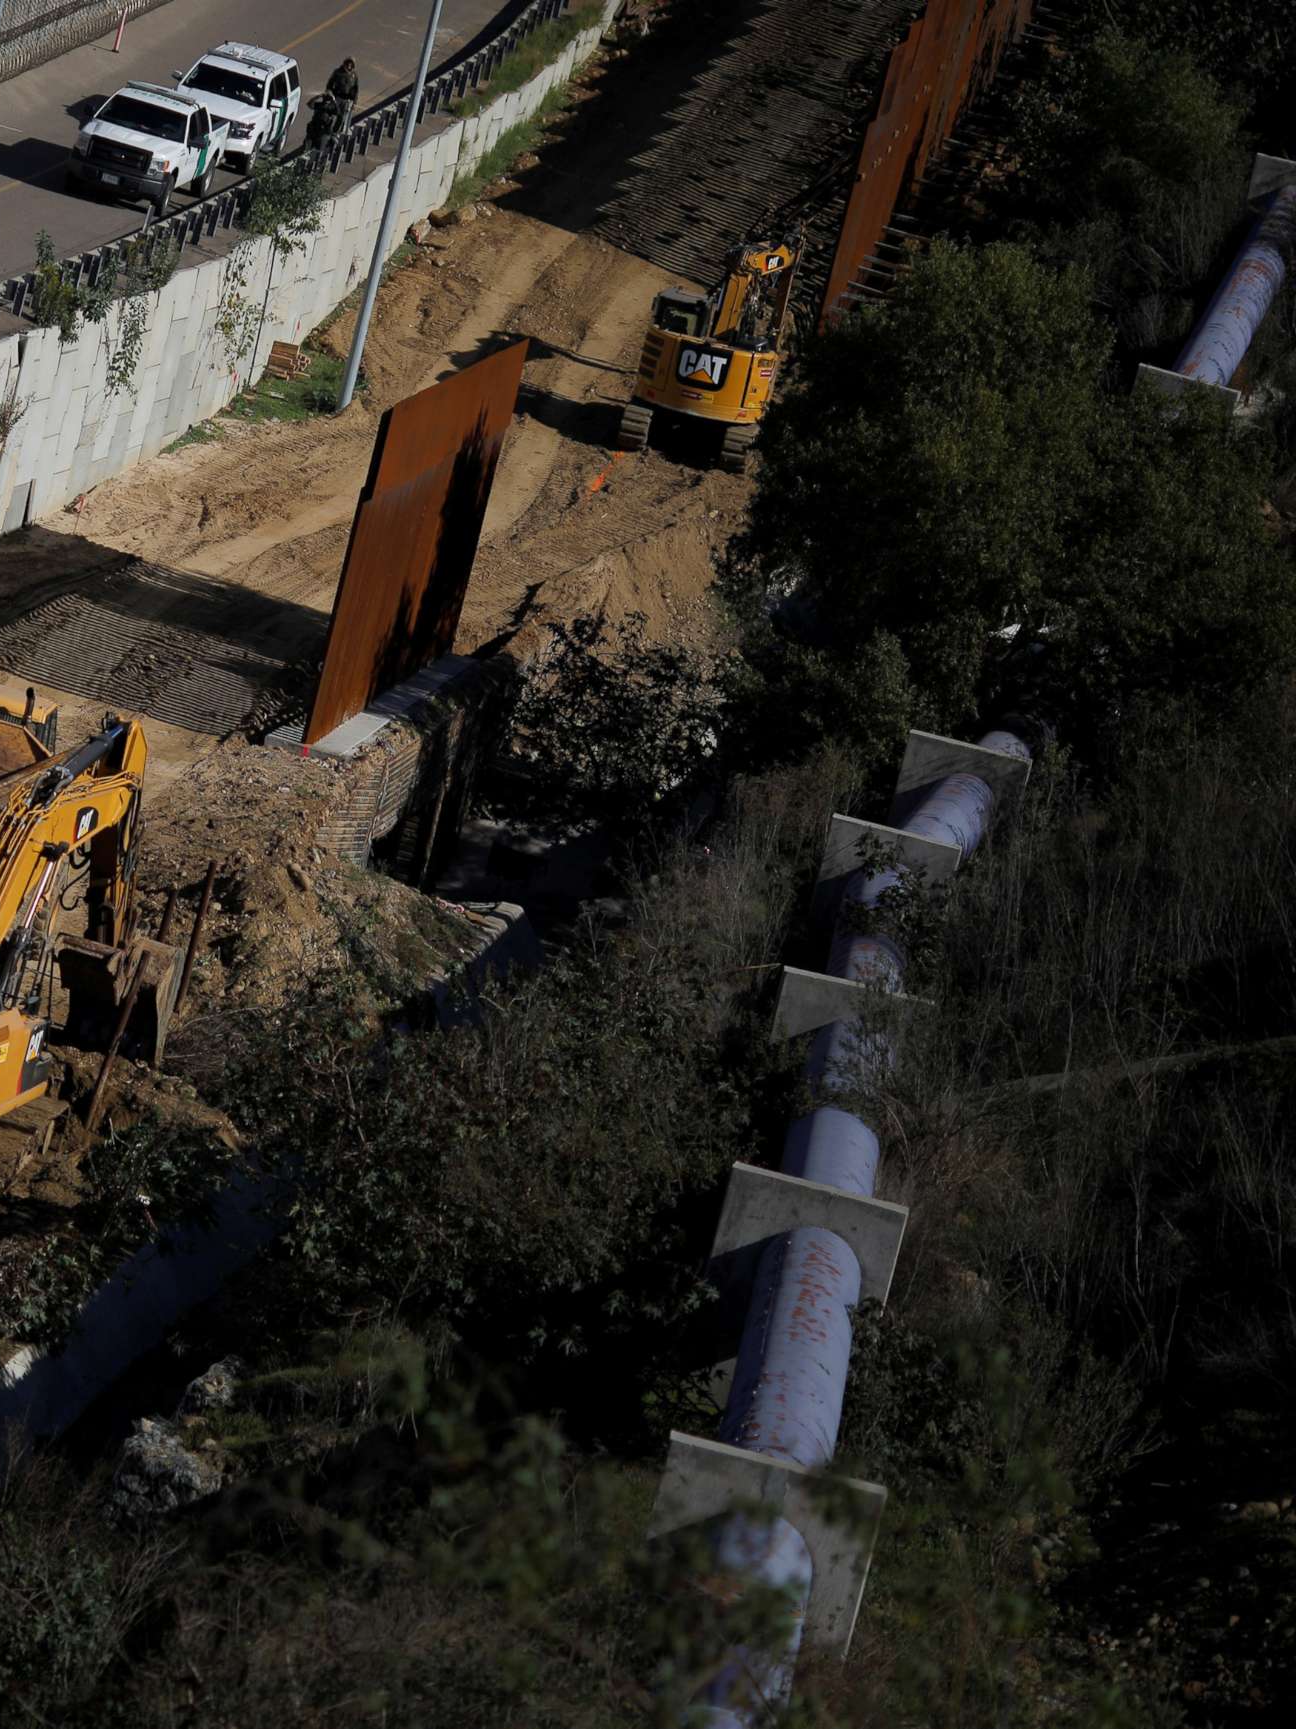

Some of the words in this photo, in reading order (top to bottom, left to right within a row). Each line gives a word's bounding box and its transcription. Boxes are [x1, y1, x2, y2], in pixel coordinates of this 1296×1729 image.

[678, 349, 728, 385] CAT
[77, 808, 95, 840] CAT
[25, 1029, 45, 1063] CAT
